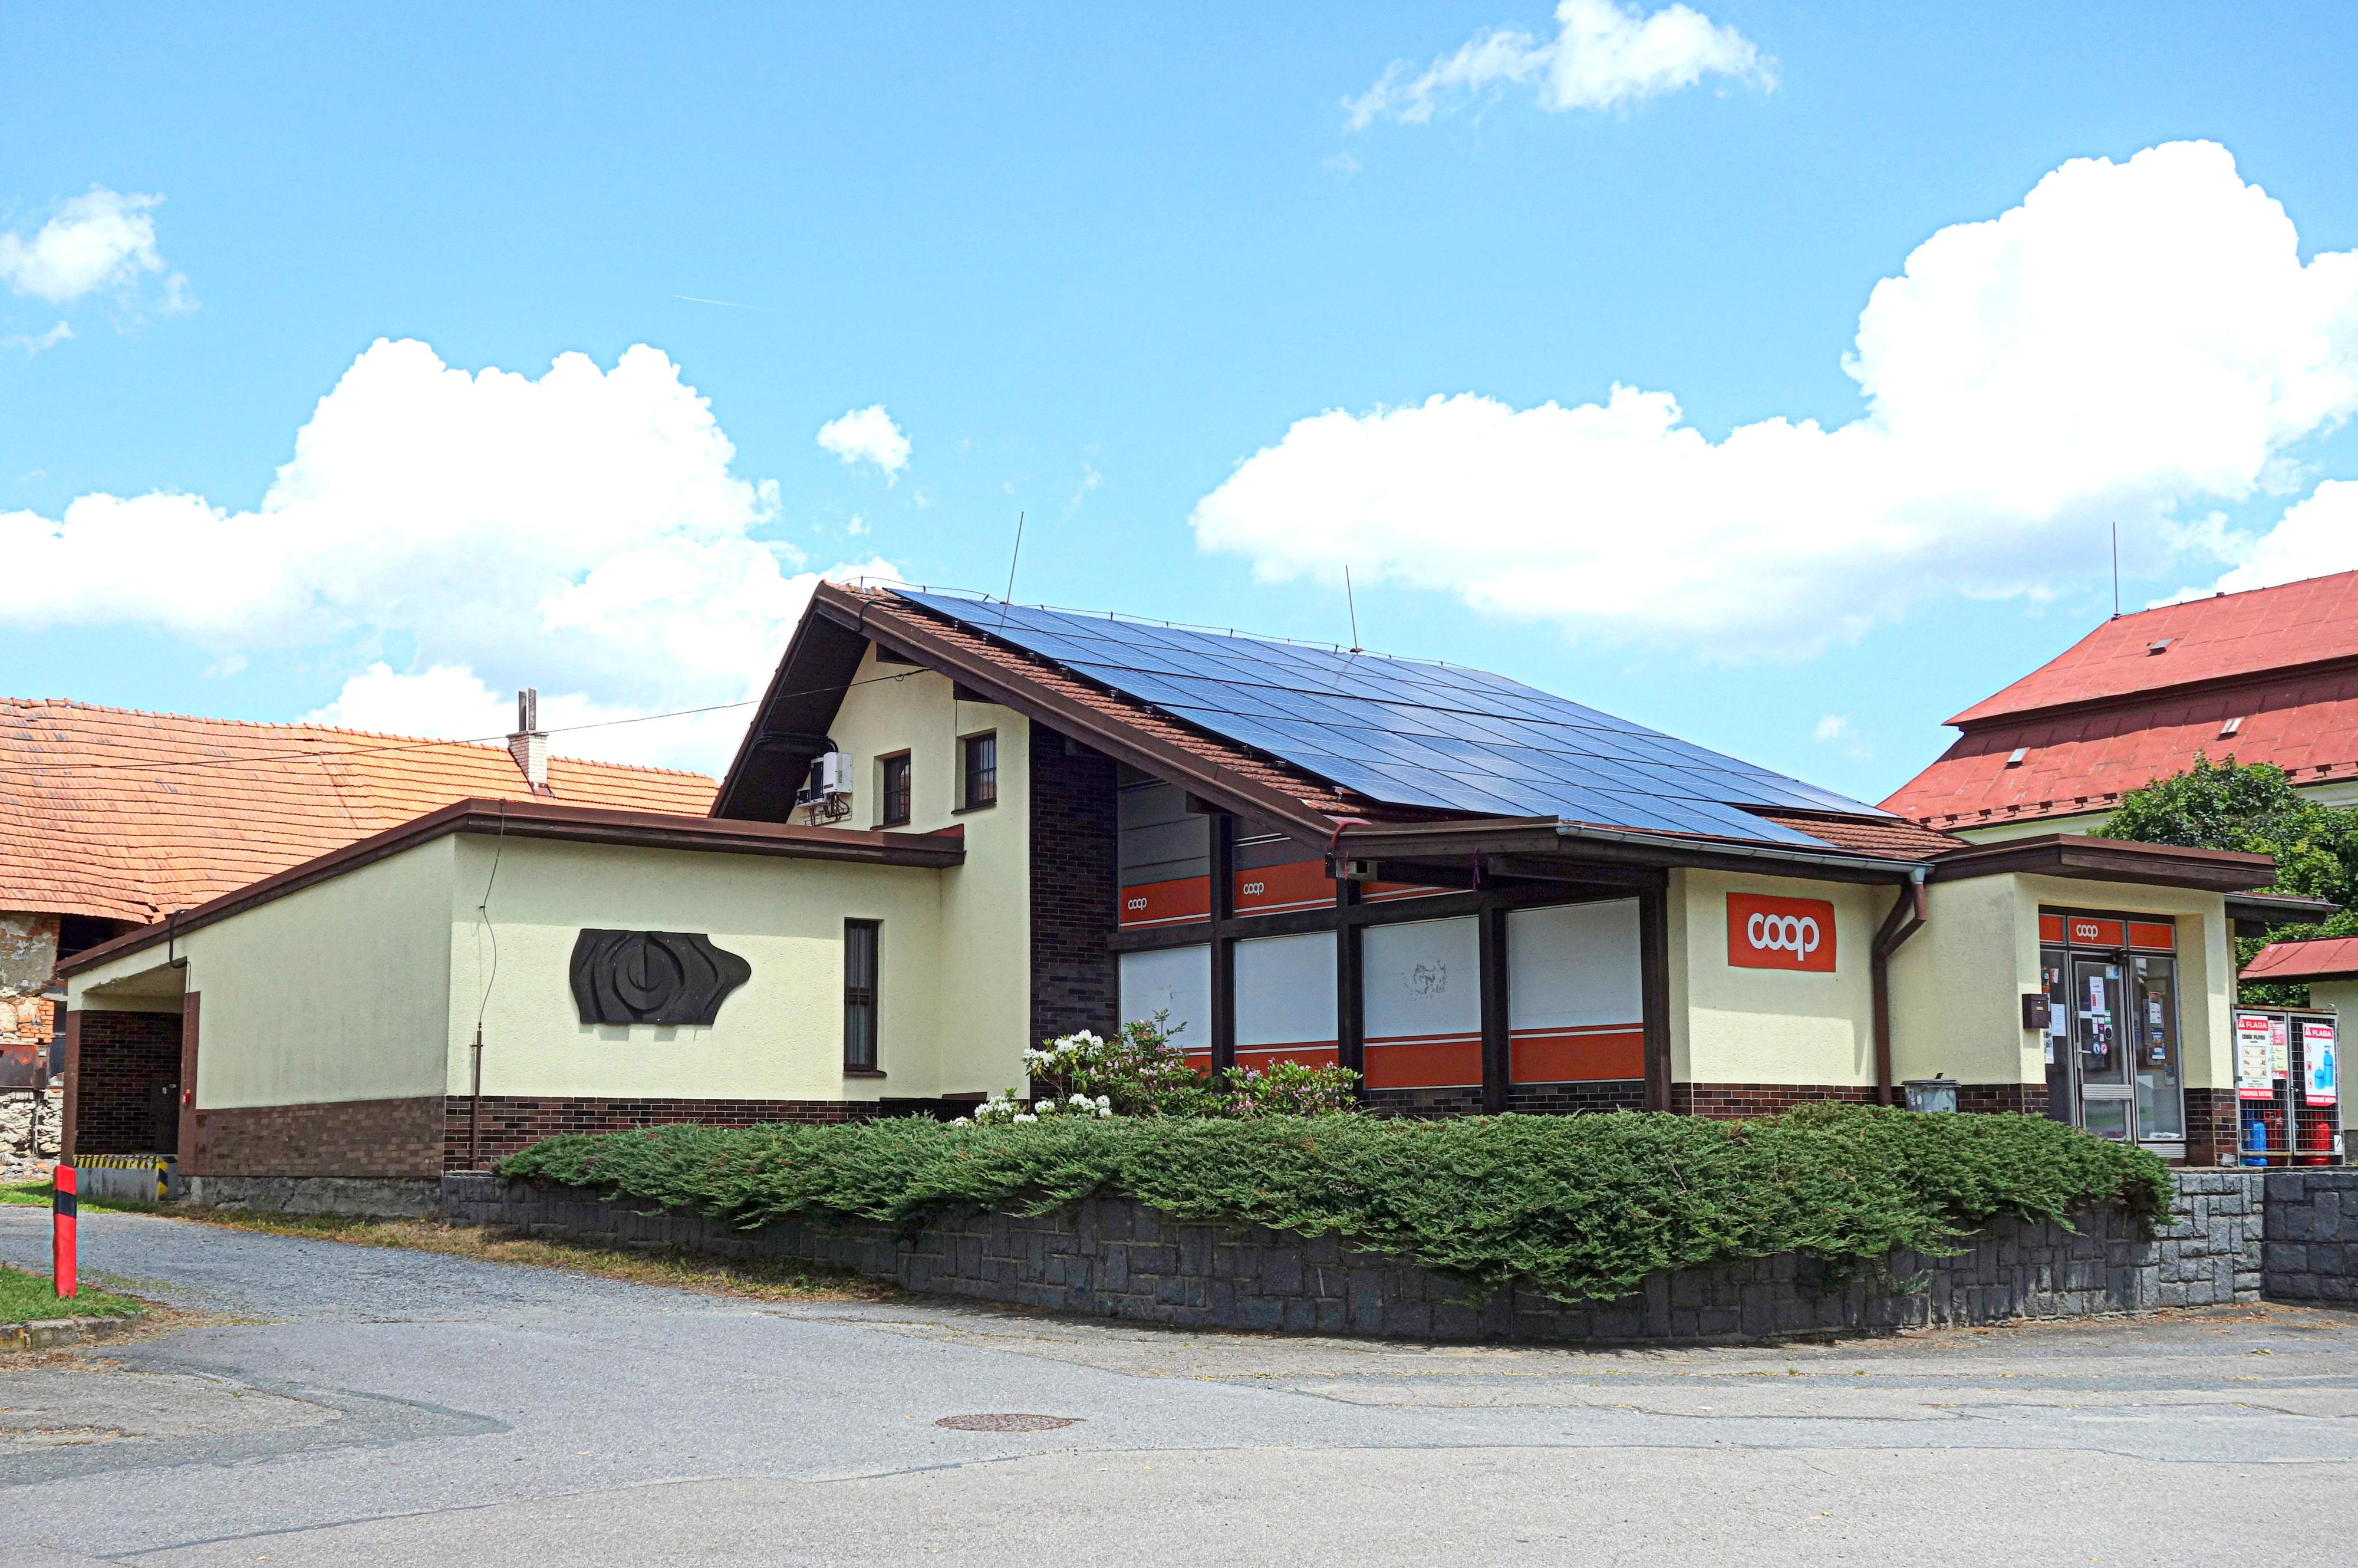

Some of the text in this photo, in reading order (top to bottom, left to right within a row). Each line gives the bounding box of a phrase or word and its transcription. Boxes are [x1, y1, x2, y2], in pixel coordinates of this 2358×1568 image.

[1243, 882, 1264, 895] coop
[1128, 897, 1147, 910] coop
[1747, 913, 1820, 961] coop
[2076, 924, 2098, 940] coop
